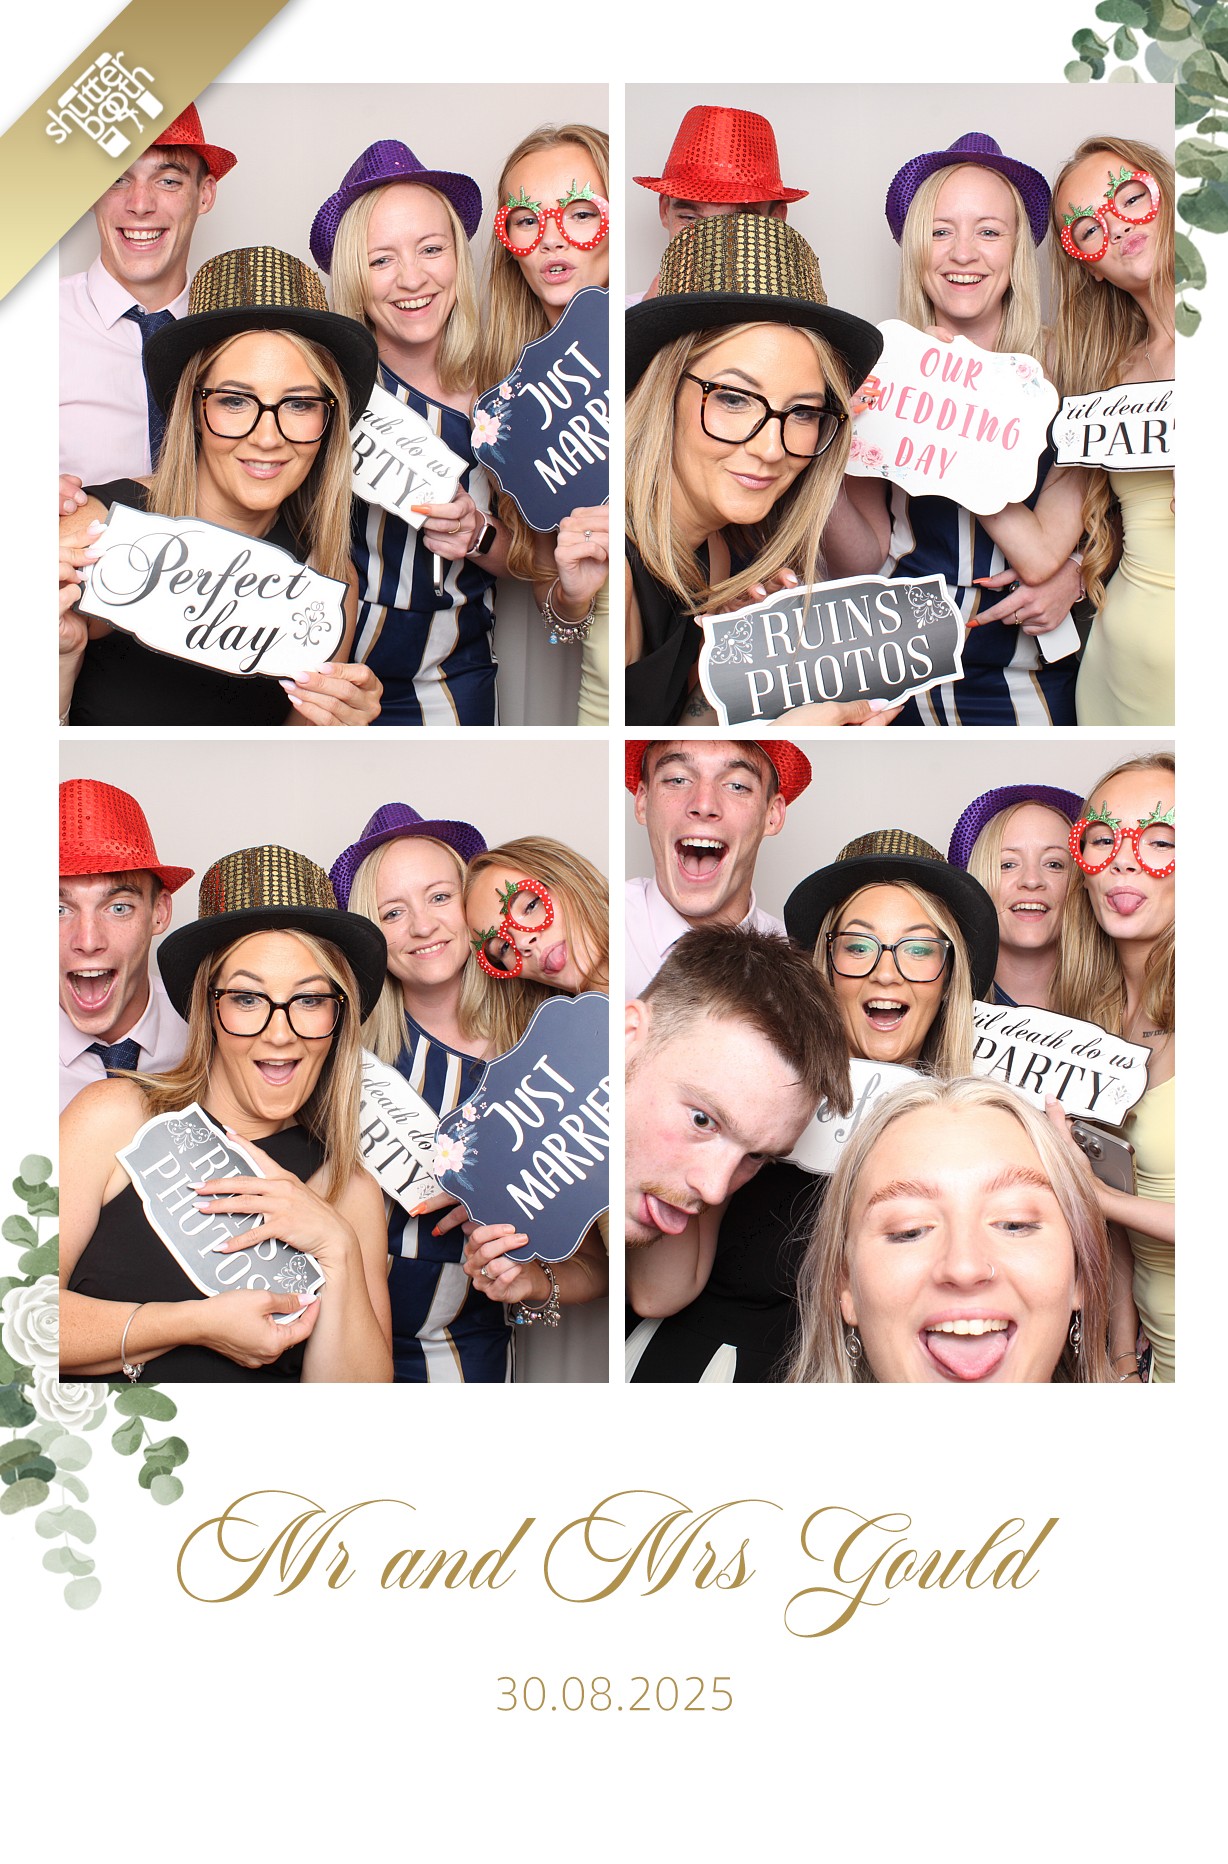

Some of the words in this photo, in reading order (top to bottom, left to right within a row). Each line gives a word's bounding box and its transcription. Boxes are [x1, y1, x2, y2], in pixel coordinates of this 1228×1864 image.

[517, 340, 602, 431] JUST
[919, 347, 983, 391] OUR
[1102, 389, 1173, 417] death
[352, 430, 431, 509] RTY
[360, 409, 404, 435] ath
[395, 436, 428, 457] do
[426, 459, 454, 478] us
[533, 388, 609, 494] MARR
[894, 436, 958, 479] DAY
[1080, 418, 1175, 458] PAR
[91, 530, 310, 622] Perfect
[185, 600, 287, 673] day
[760, 589, 902, 659] RUINS
[745, 634, 933, 717] PHOTOS
[973, 1036, 1120, 1112] PARTY
[1000, 1018, 1074, 1050] death
[1070, 1037, 1106, 1060] do
[1109, 1053, 1142, 1070] us
[361, 1078, 420, 1125] death
[483, 1054, 575, 1152] JUST
[359, 1100, 434, 1196] RTY
[506, 1075, 609, 1220] MARRIE
